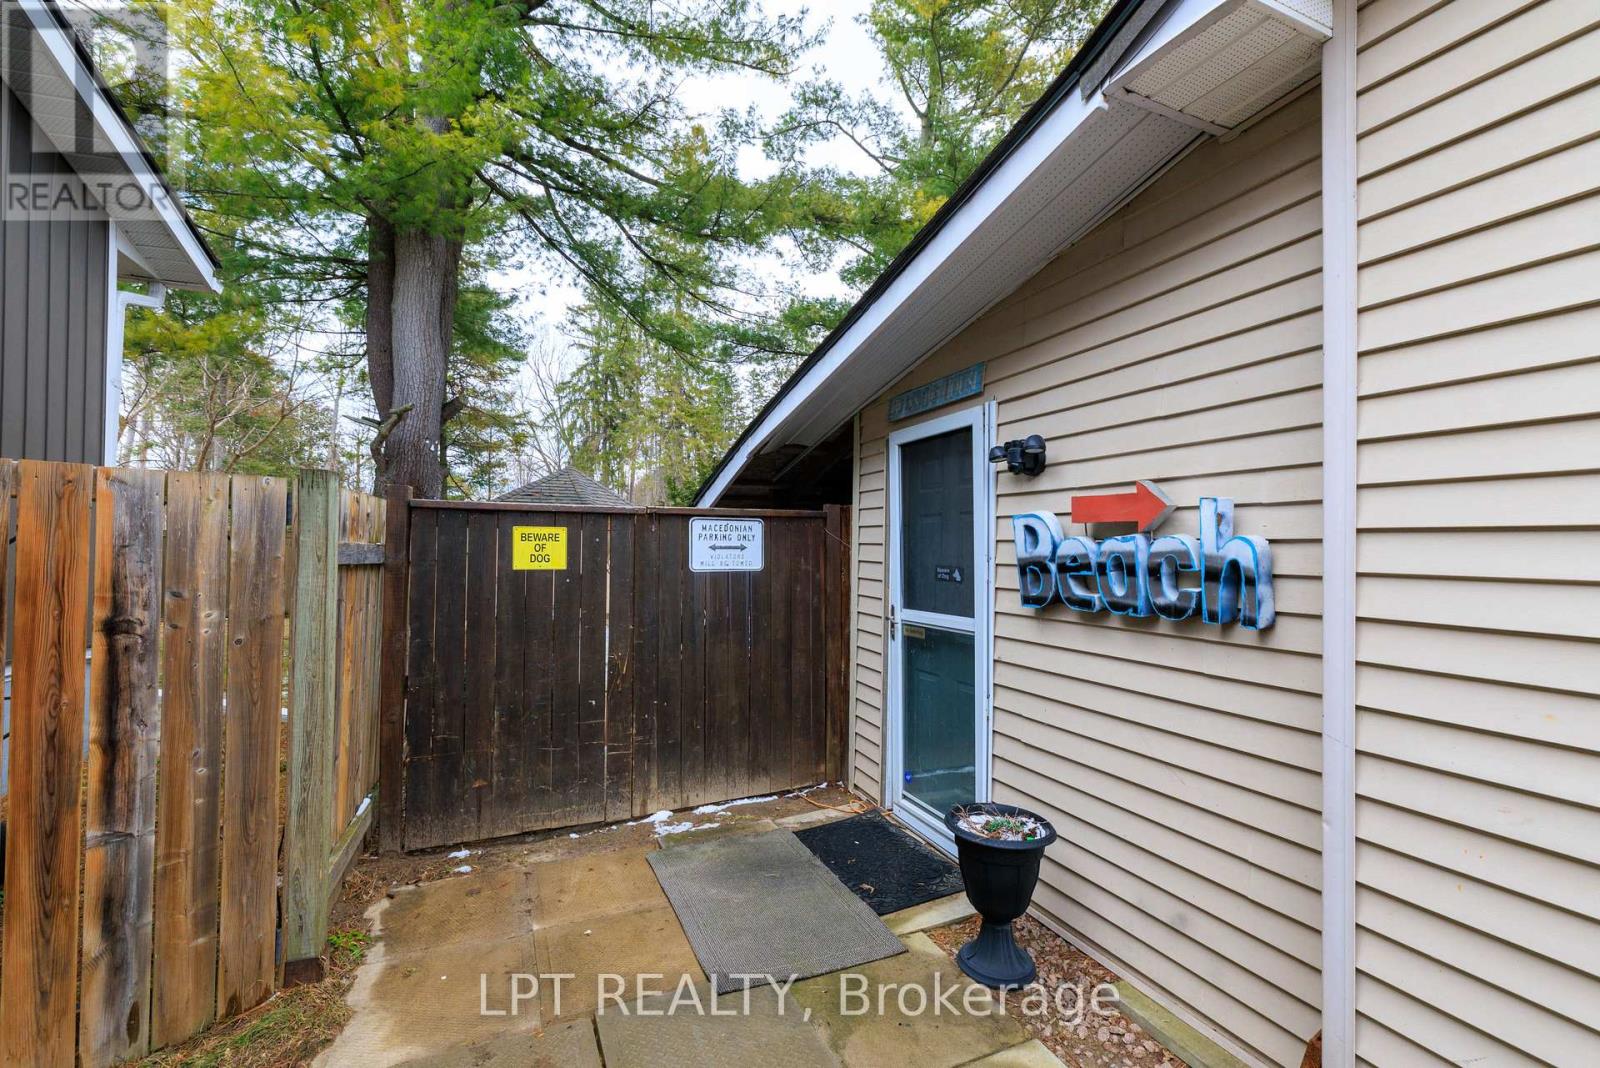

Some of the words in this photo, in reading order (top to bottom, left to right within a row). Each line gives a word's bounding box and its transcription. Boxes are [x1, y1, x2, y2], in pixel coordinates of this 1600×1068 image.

[701, 524, 753, 532] MACEDONIAN
[520, 532, 560, 542] BEWARE
[698, 533, 732, 541] PARKING
[534, 543, 547, 552] OF
[529, 553, 550, 563] DOG
[1012, 496, 1276, 631] Beach
